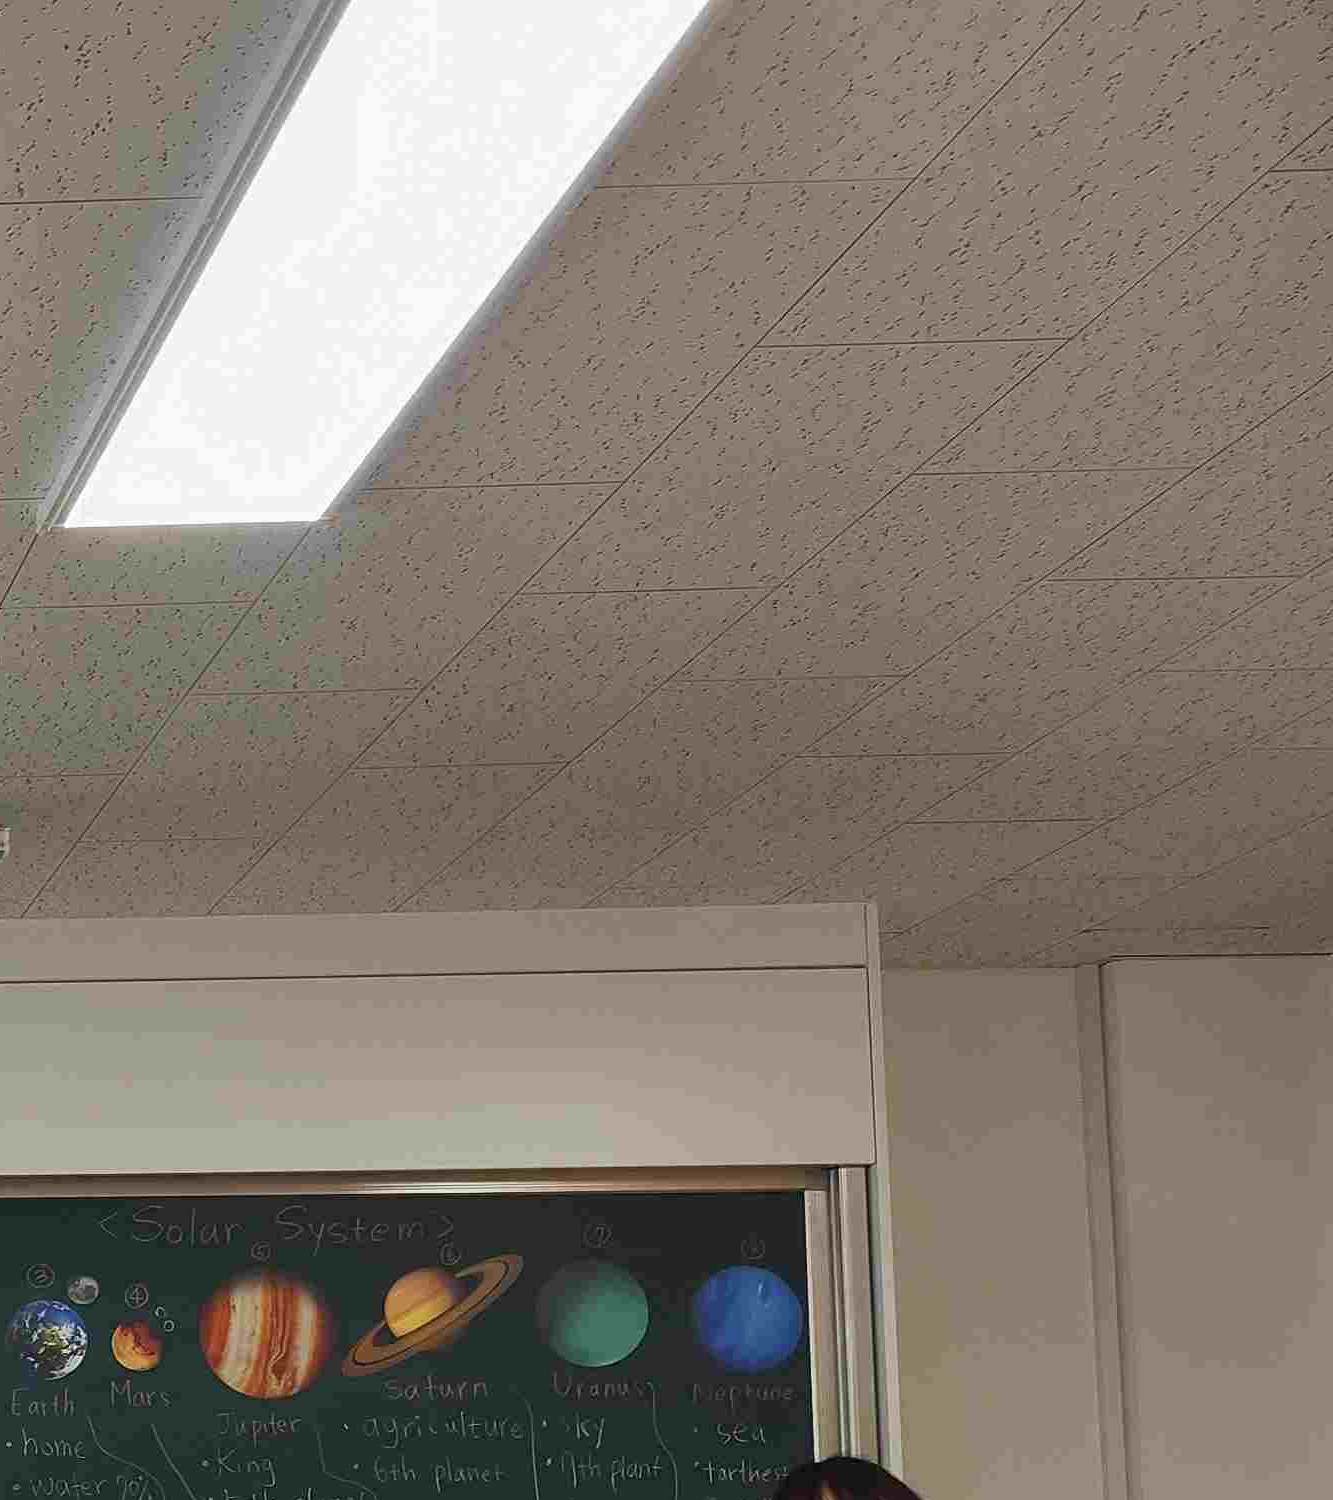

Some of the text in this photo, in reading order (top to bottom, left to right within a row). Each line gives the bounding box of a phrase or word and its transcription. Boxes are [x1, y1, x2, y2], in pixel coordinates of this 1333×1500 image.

[11, 1384, 77, 1416] Earth
[109, 1377, 173, 1408] Mars
[20, 1424, 86, 1460] home
[214, 1407, 302, 1448] Jupiter
[433, 1455, 510, 1496] planet
